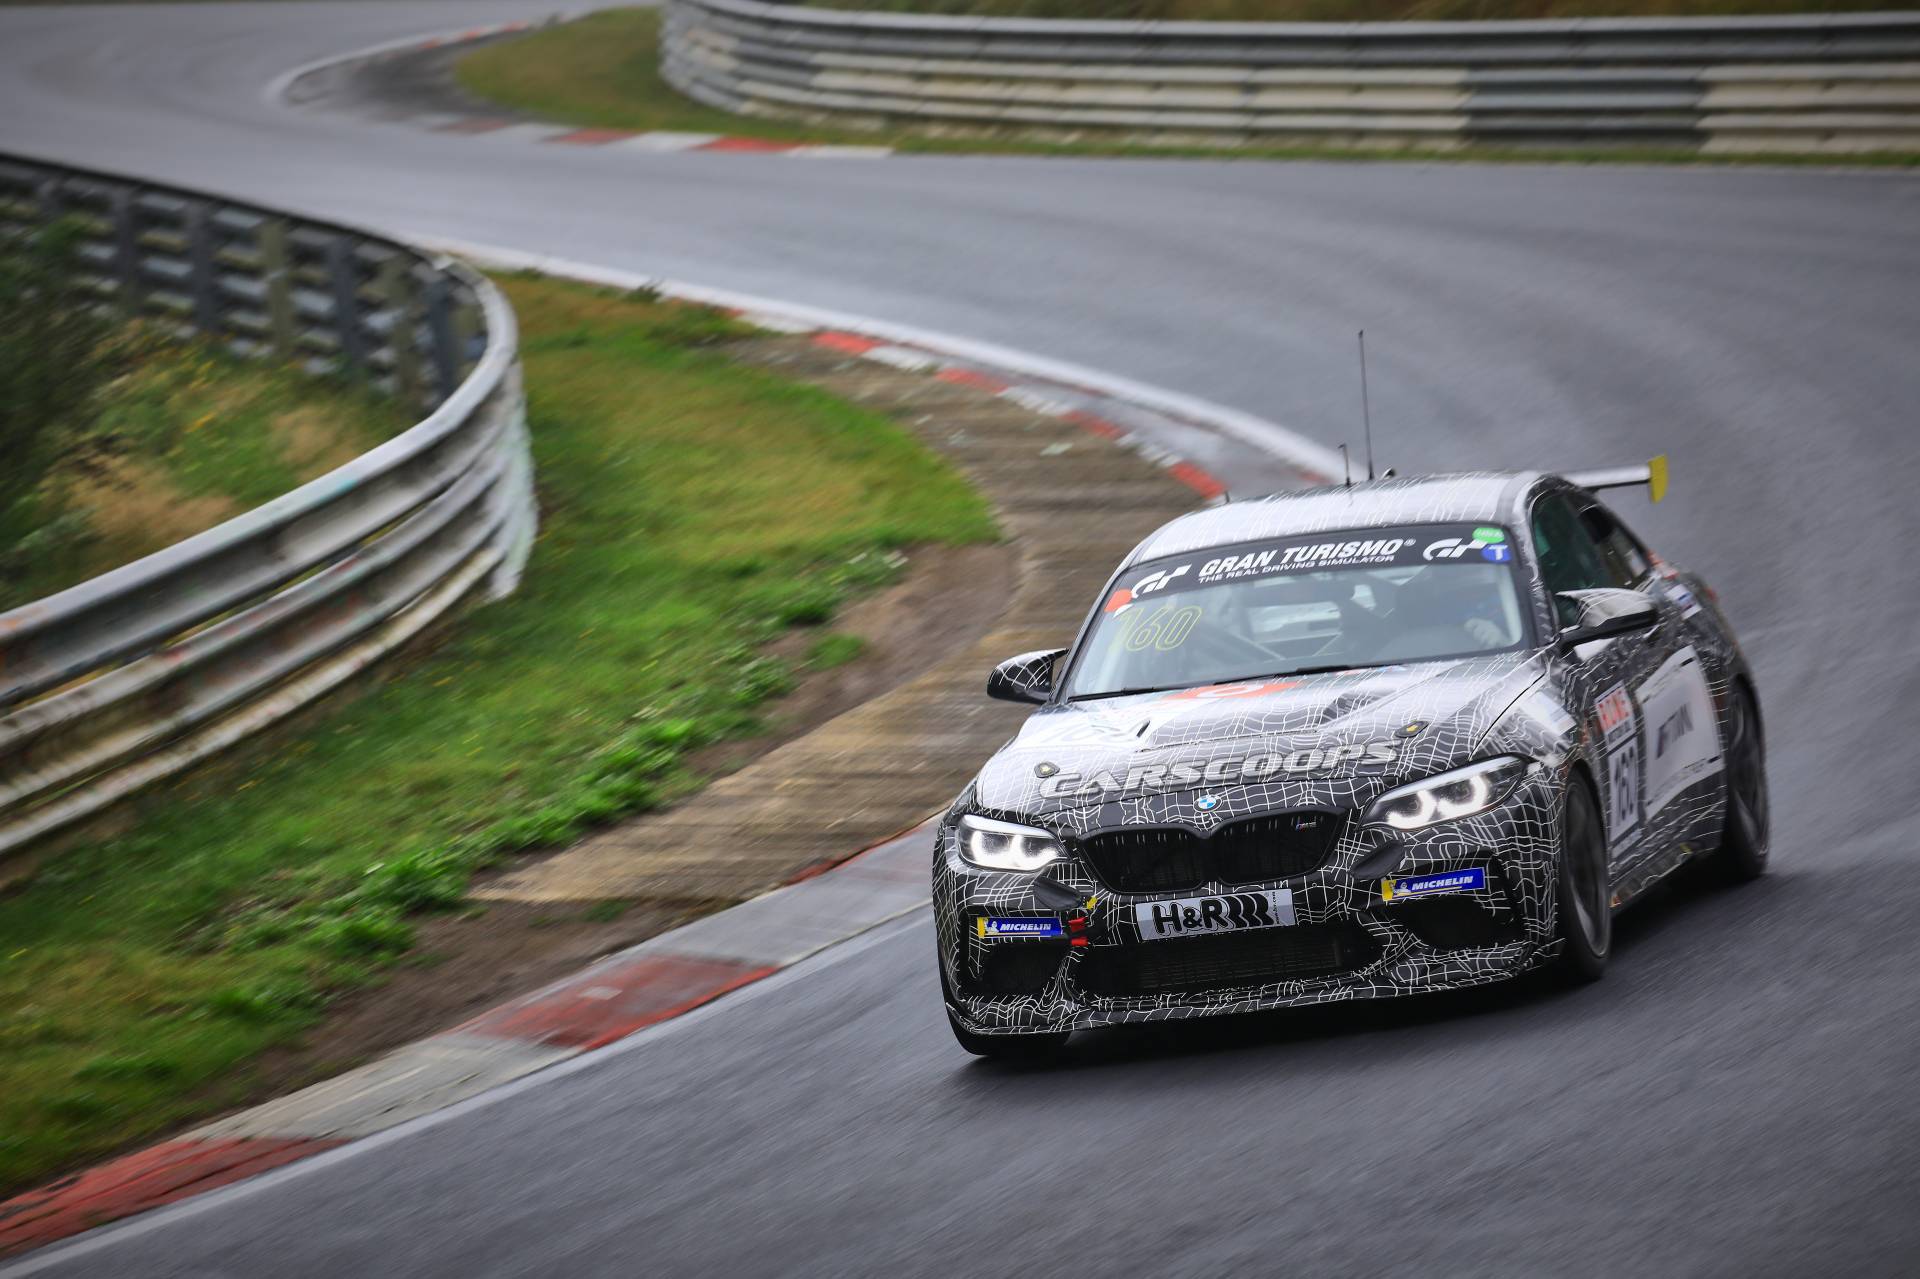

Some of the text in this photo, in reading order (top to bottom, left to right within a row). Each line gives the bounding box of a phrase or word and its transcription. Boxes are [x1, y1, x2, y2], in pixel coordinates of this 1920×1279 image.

[1488, 544, 1508, 560] T
[1198, 550, 1278, 577] GRAN
[1199, 555, 1395, 584] THE REAL DRIVING SIMULATOR
[1039, 739, 1399, 799] CARSCOOPS
[1412, 875, 1474, 891] MICHELIN
[999, 923, 1052, 931] MICHELIN
